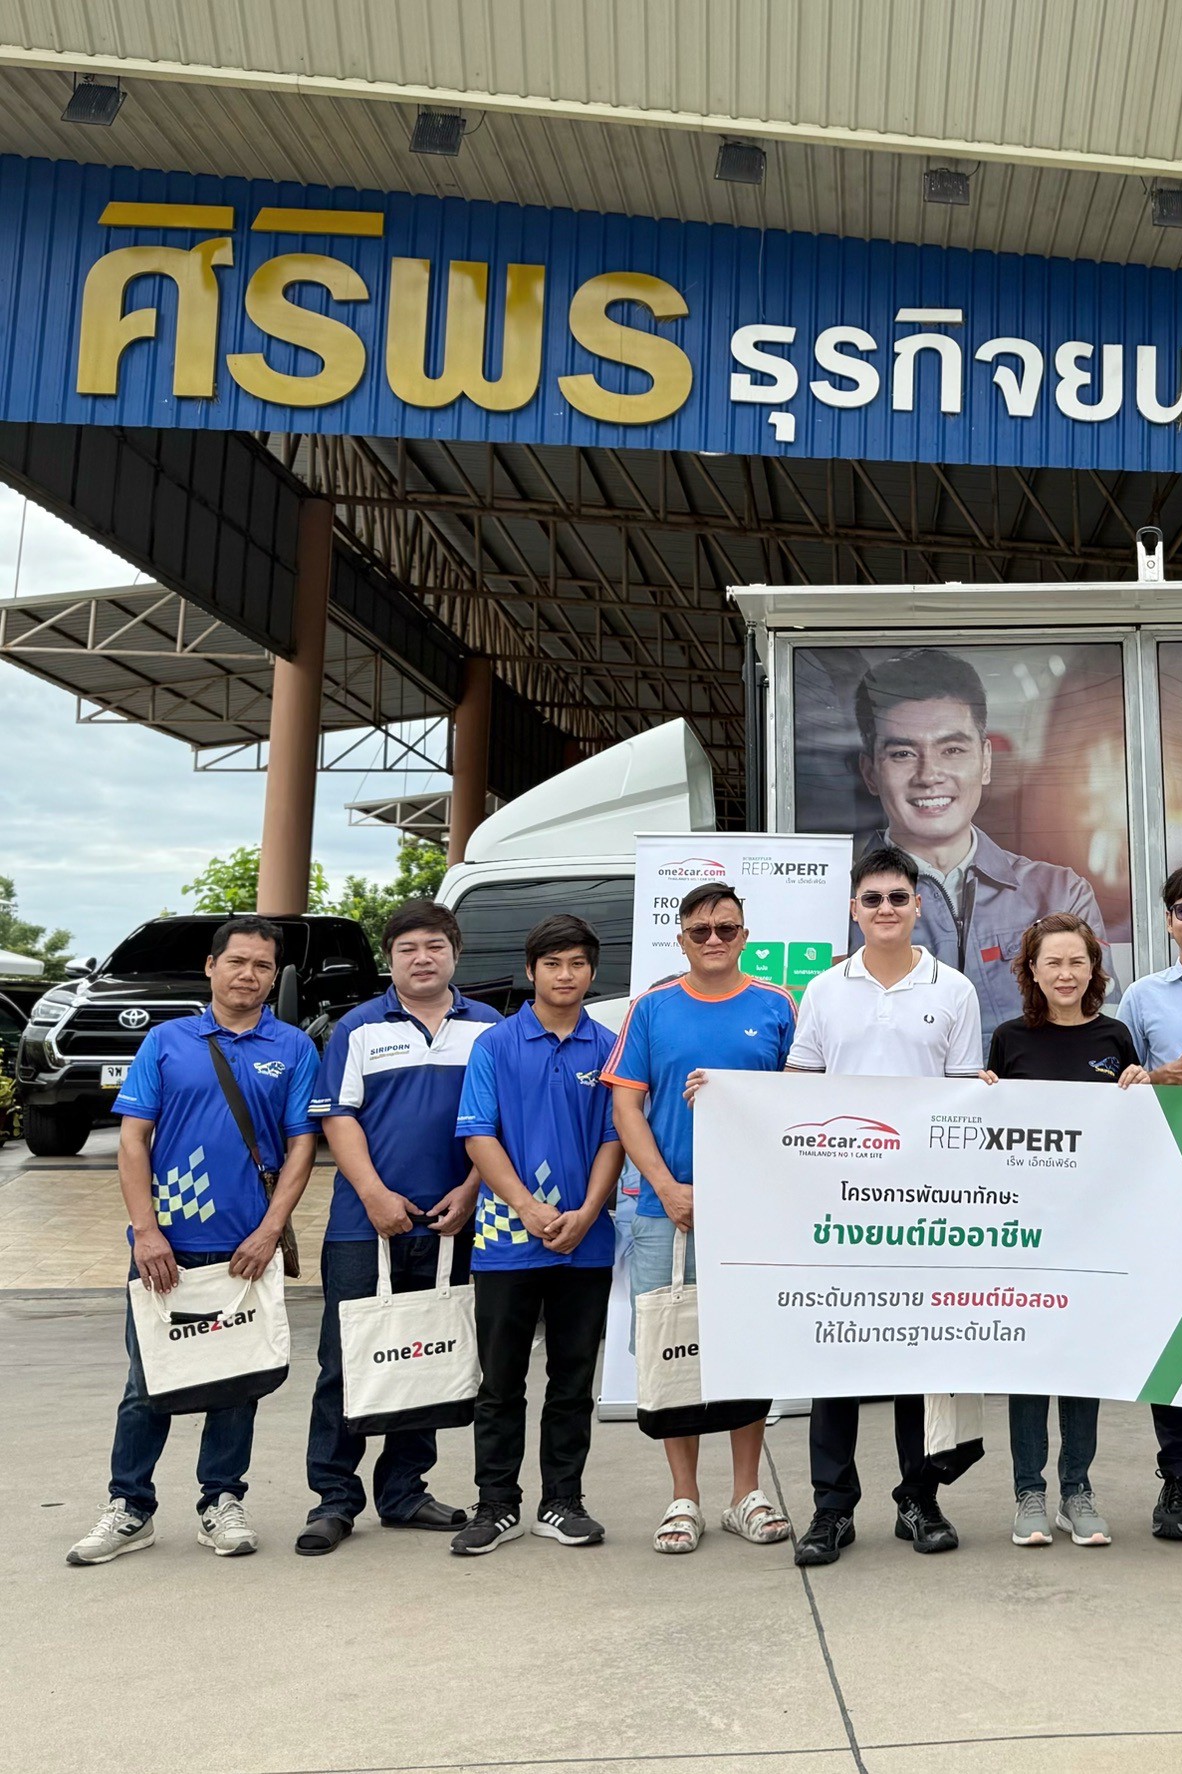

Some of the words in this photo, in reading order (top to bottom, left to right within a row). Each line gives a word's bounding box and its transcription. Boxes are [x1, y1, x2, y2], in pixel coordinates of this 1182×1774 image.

[76, 201, 694, 425] ศิริพร
[658, 867, 726, 876] one2car.com
[653, 897, 682, 909] FRO
[653, 914, 670, 924] TO
[370, 1044, 410, 1055] SIRIPORN
[931, 1115, 983, 1123] SCHAEFFLER
[782, 1133, 901, 1150] one2car.com
[799, 1150, 836, 1158] THAILAND'S
[841, 1181, 1019, 1204] โครงการพัฒนาทักษะ
[813, 1213, 1042, 1248] ช่างยนต์มืออาชีพ
[777, 1286, 924, 1307] ยกระดับการขาย
[931, 1287, 1069, 1309] รถยนต์มือสอง
[814, 1320, 1026, 1346] ให้ได้มาตรฐานระดับโลก
[373, 1339, 457, 1364] one2car
[662, 1343, 699, 1361] one
